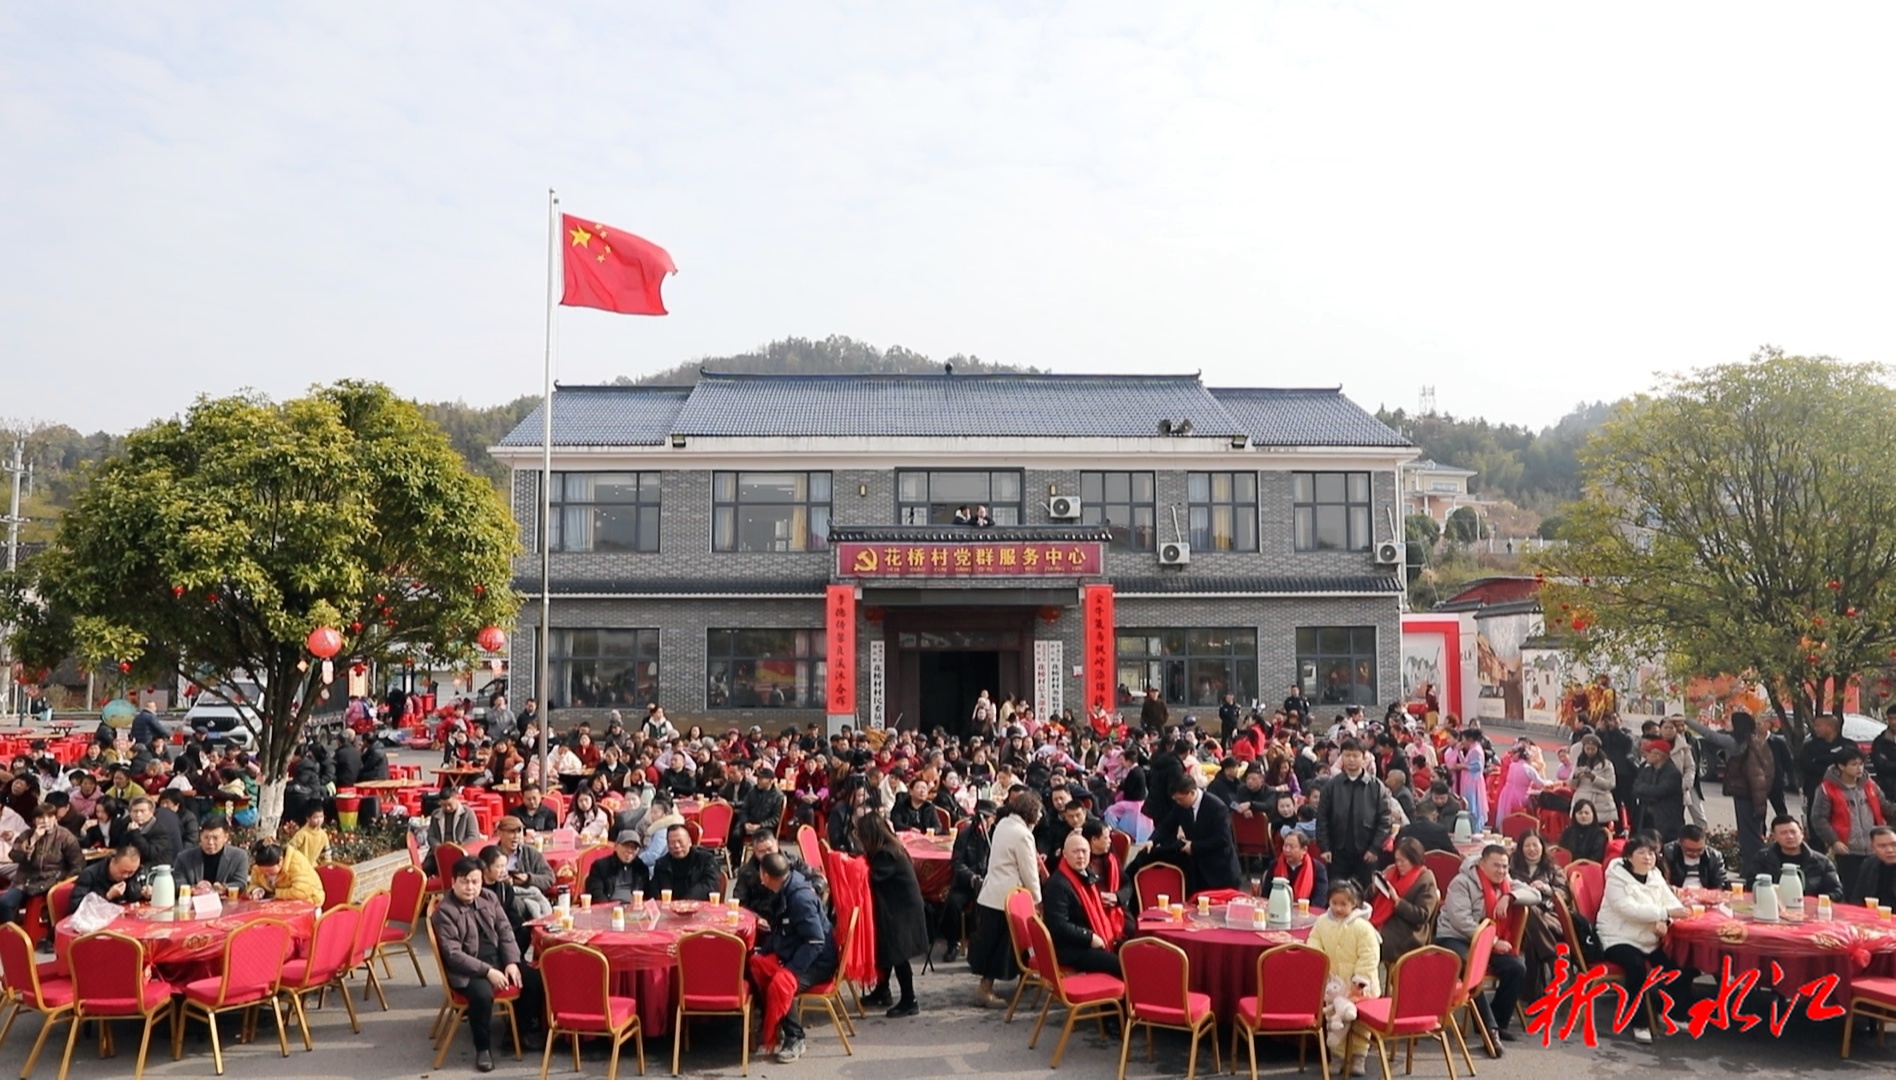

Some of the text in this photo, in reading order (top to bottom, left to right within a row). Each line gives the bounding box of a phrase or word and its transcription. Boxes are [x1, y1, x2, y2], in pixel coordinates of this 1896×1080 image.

[884, 547, 1087, 566] 花桥村党群服务中心
